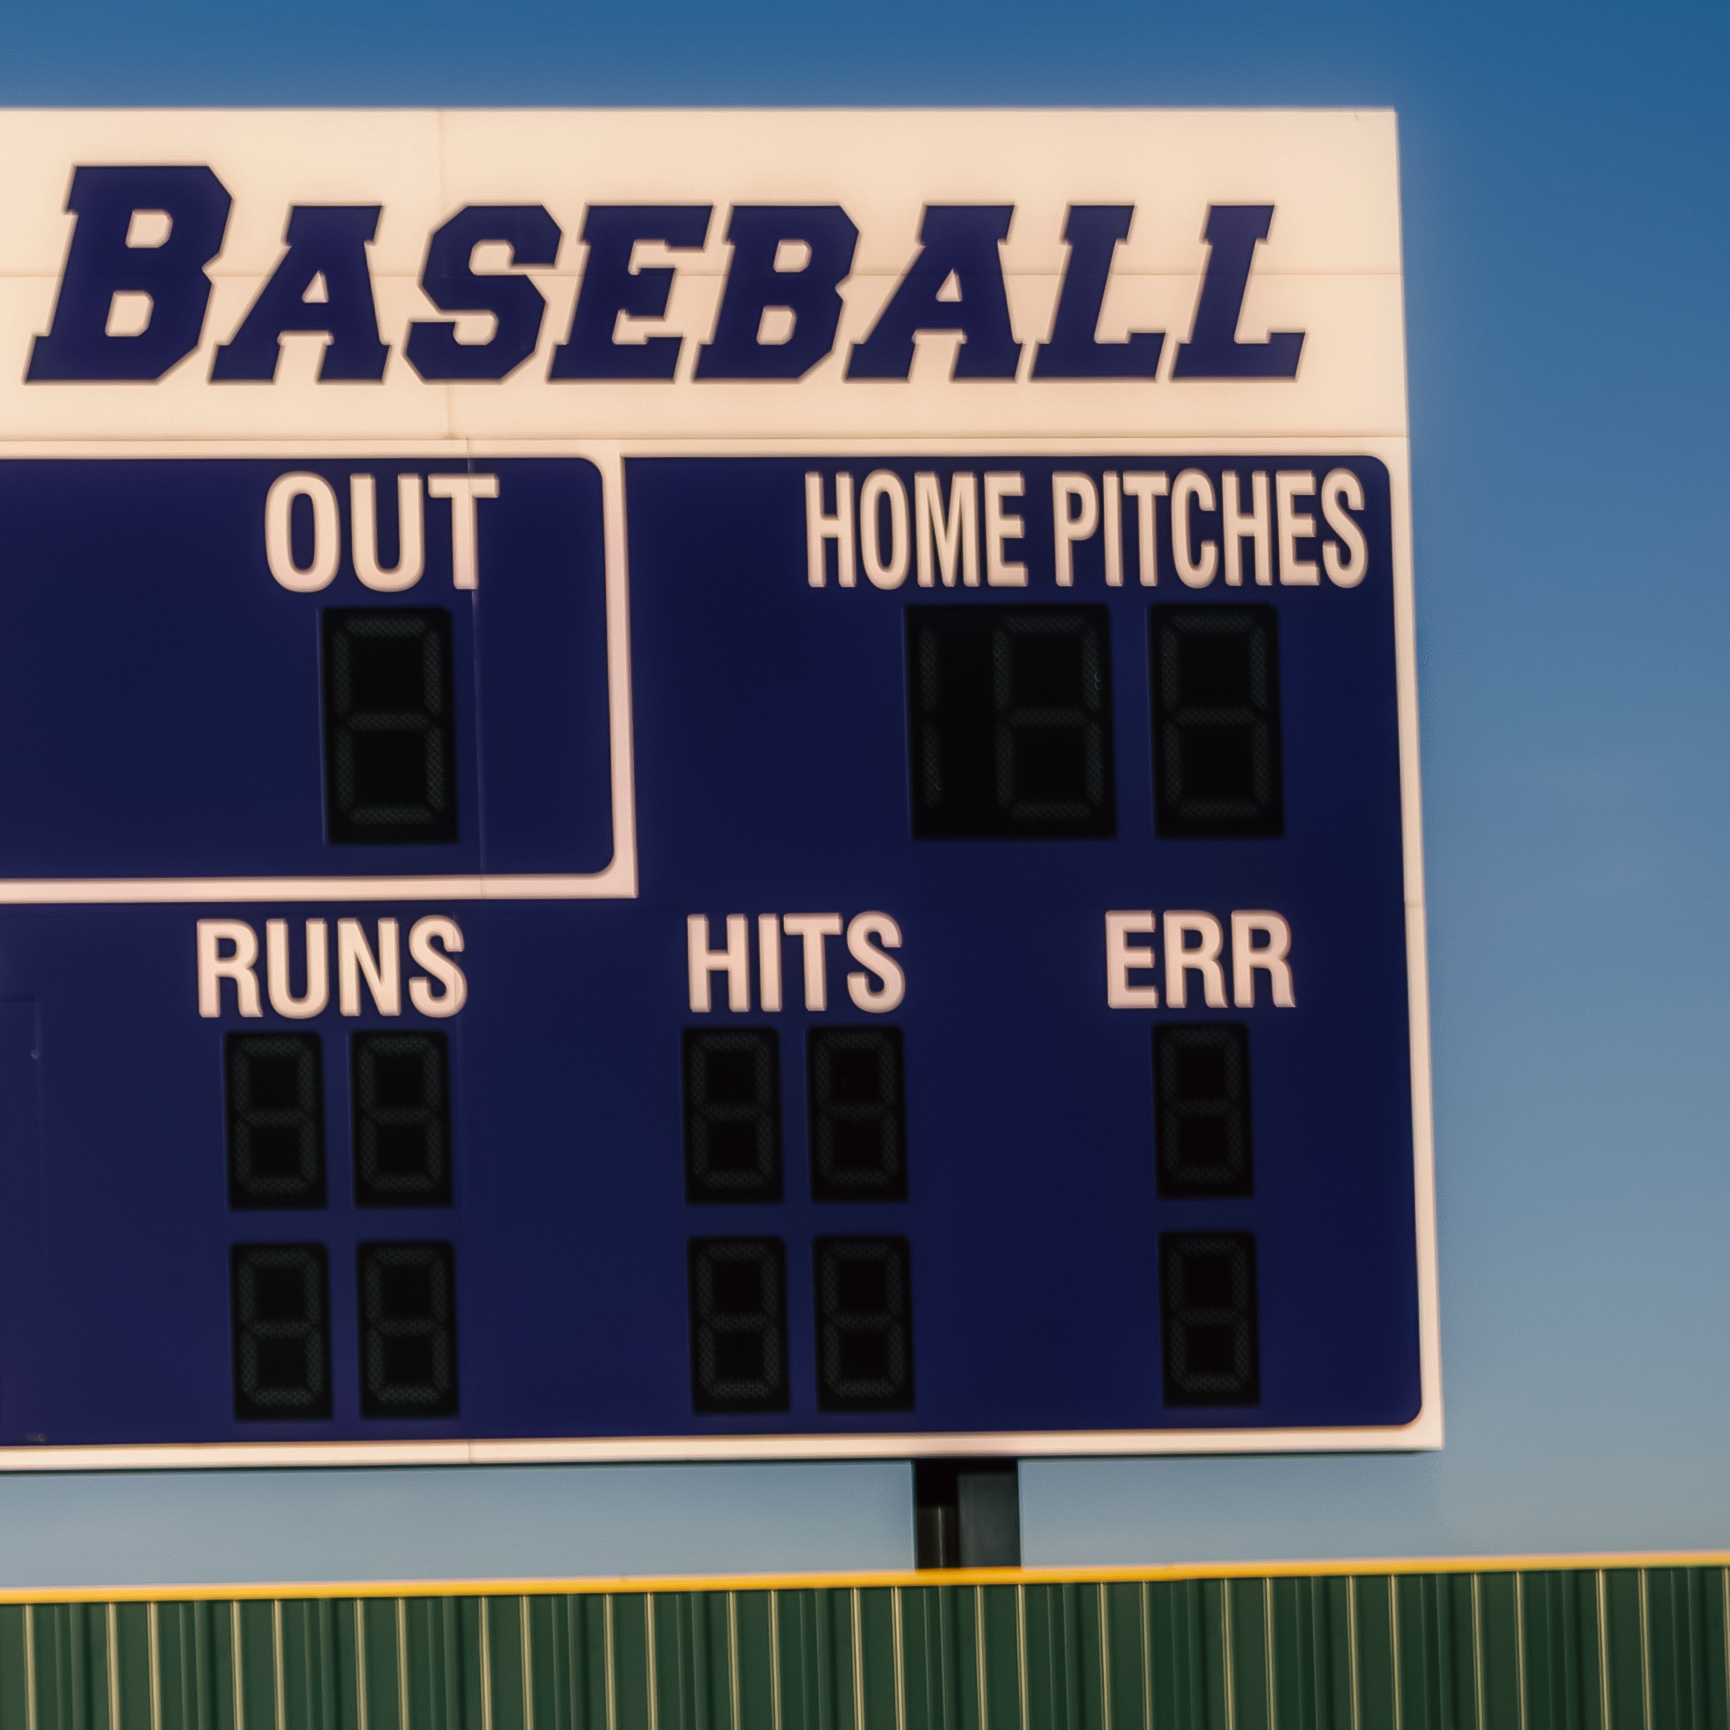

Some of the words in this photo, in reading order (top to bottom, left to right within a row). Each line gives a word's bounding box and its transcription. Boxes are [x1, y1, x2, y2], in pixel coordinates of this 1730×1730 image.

[23, 165, 1307, 384] BASEBALL
[263, 471, 500, 593] OUT
[804, 470, 1029, 590] HOME
[1051, 467, 1369, 590] PITCHES
[195, 915, 468, 1019] RUNS
[686, 911, 906, 1013] HITS
[1105, 910, 1297, 1009] ERR
